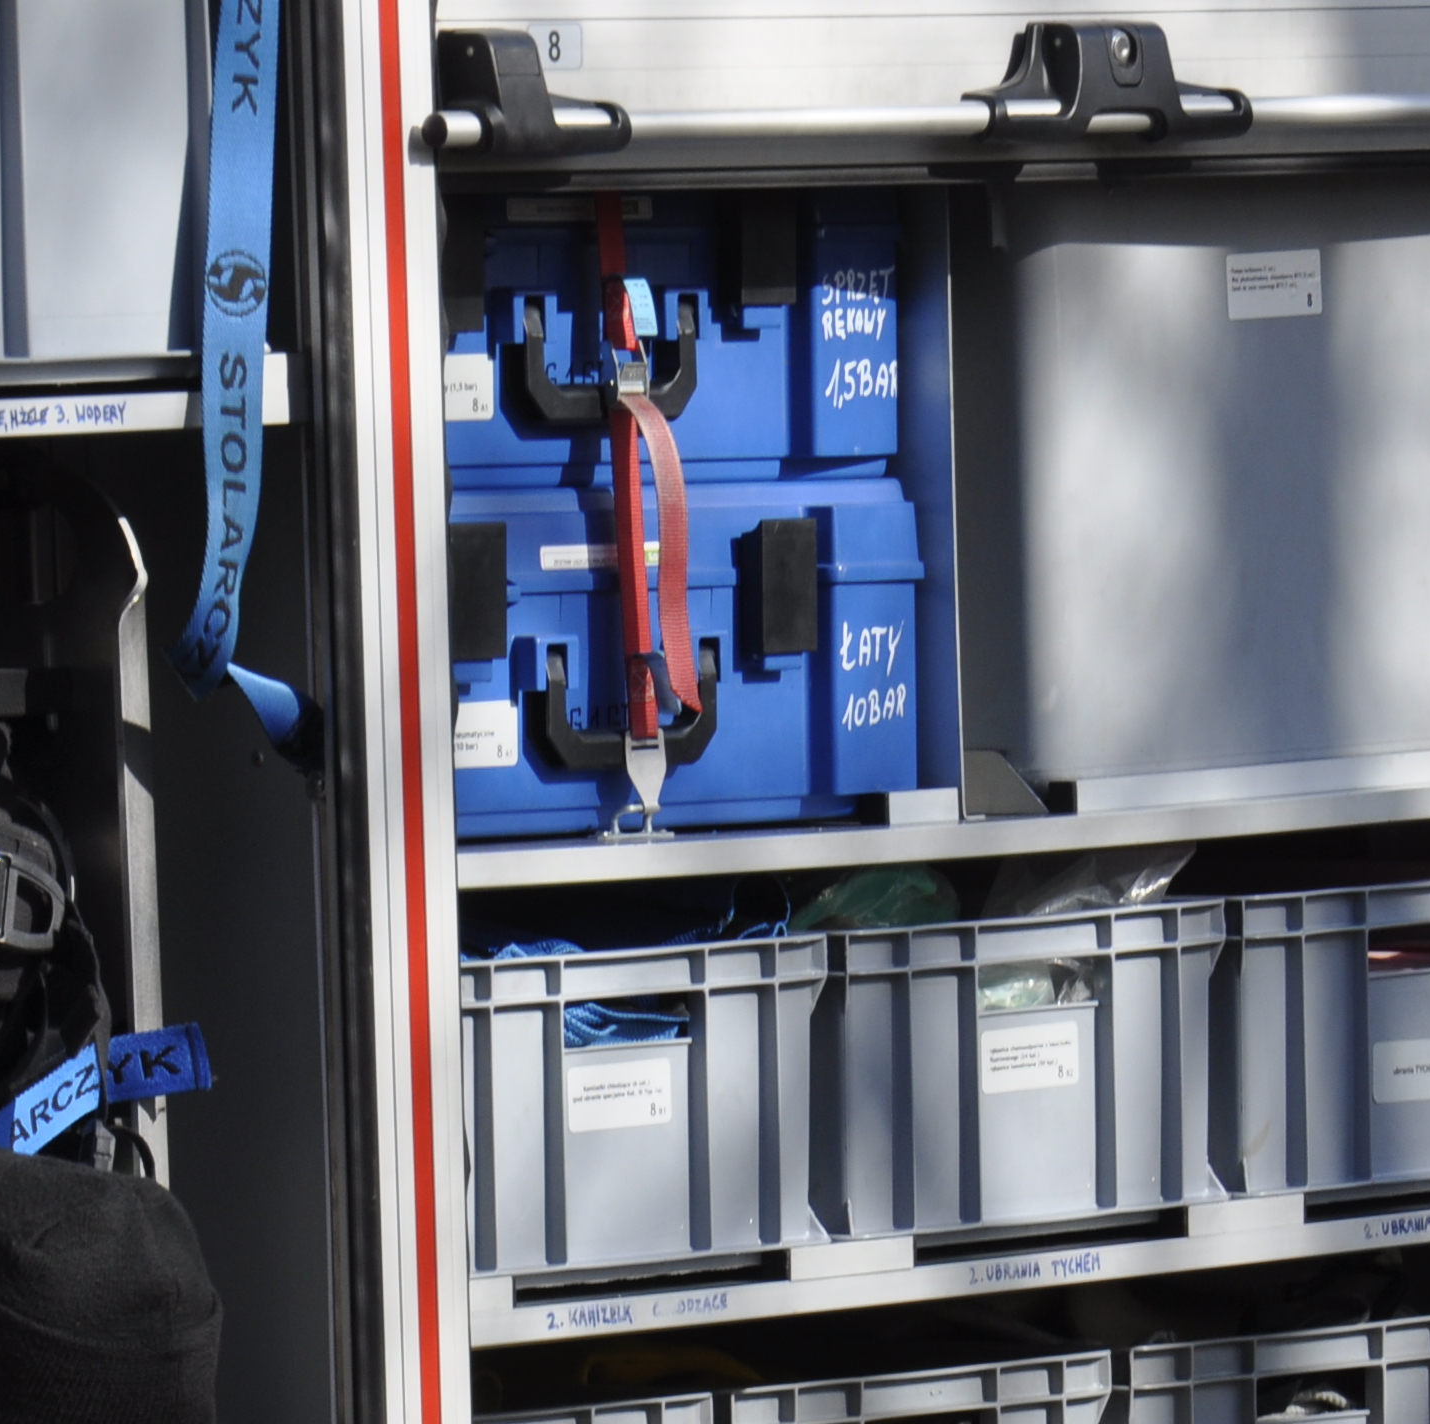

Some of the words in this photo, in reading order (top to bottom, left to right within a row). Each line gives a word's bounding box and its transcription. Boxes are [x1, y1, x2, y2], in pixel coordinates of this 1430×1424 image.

[547, 29, 561, 63] 8
[1307, 292, 1314, 308] 8
[821, 307, 887, 342] RĘKAWY
[472, 397, 479, 413] 8
[839, 619, 905, 678] ŁATY
[496, 744, 503, 759] 8
[1057, 1064, 1065, 1079] 8
[650, 1102, 657, 1117] 8
[985, 1260, 1041, 1282] UBRANIA
[1050, 1252, 1101, 1279] TYCHEM
